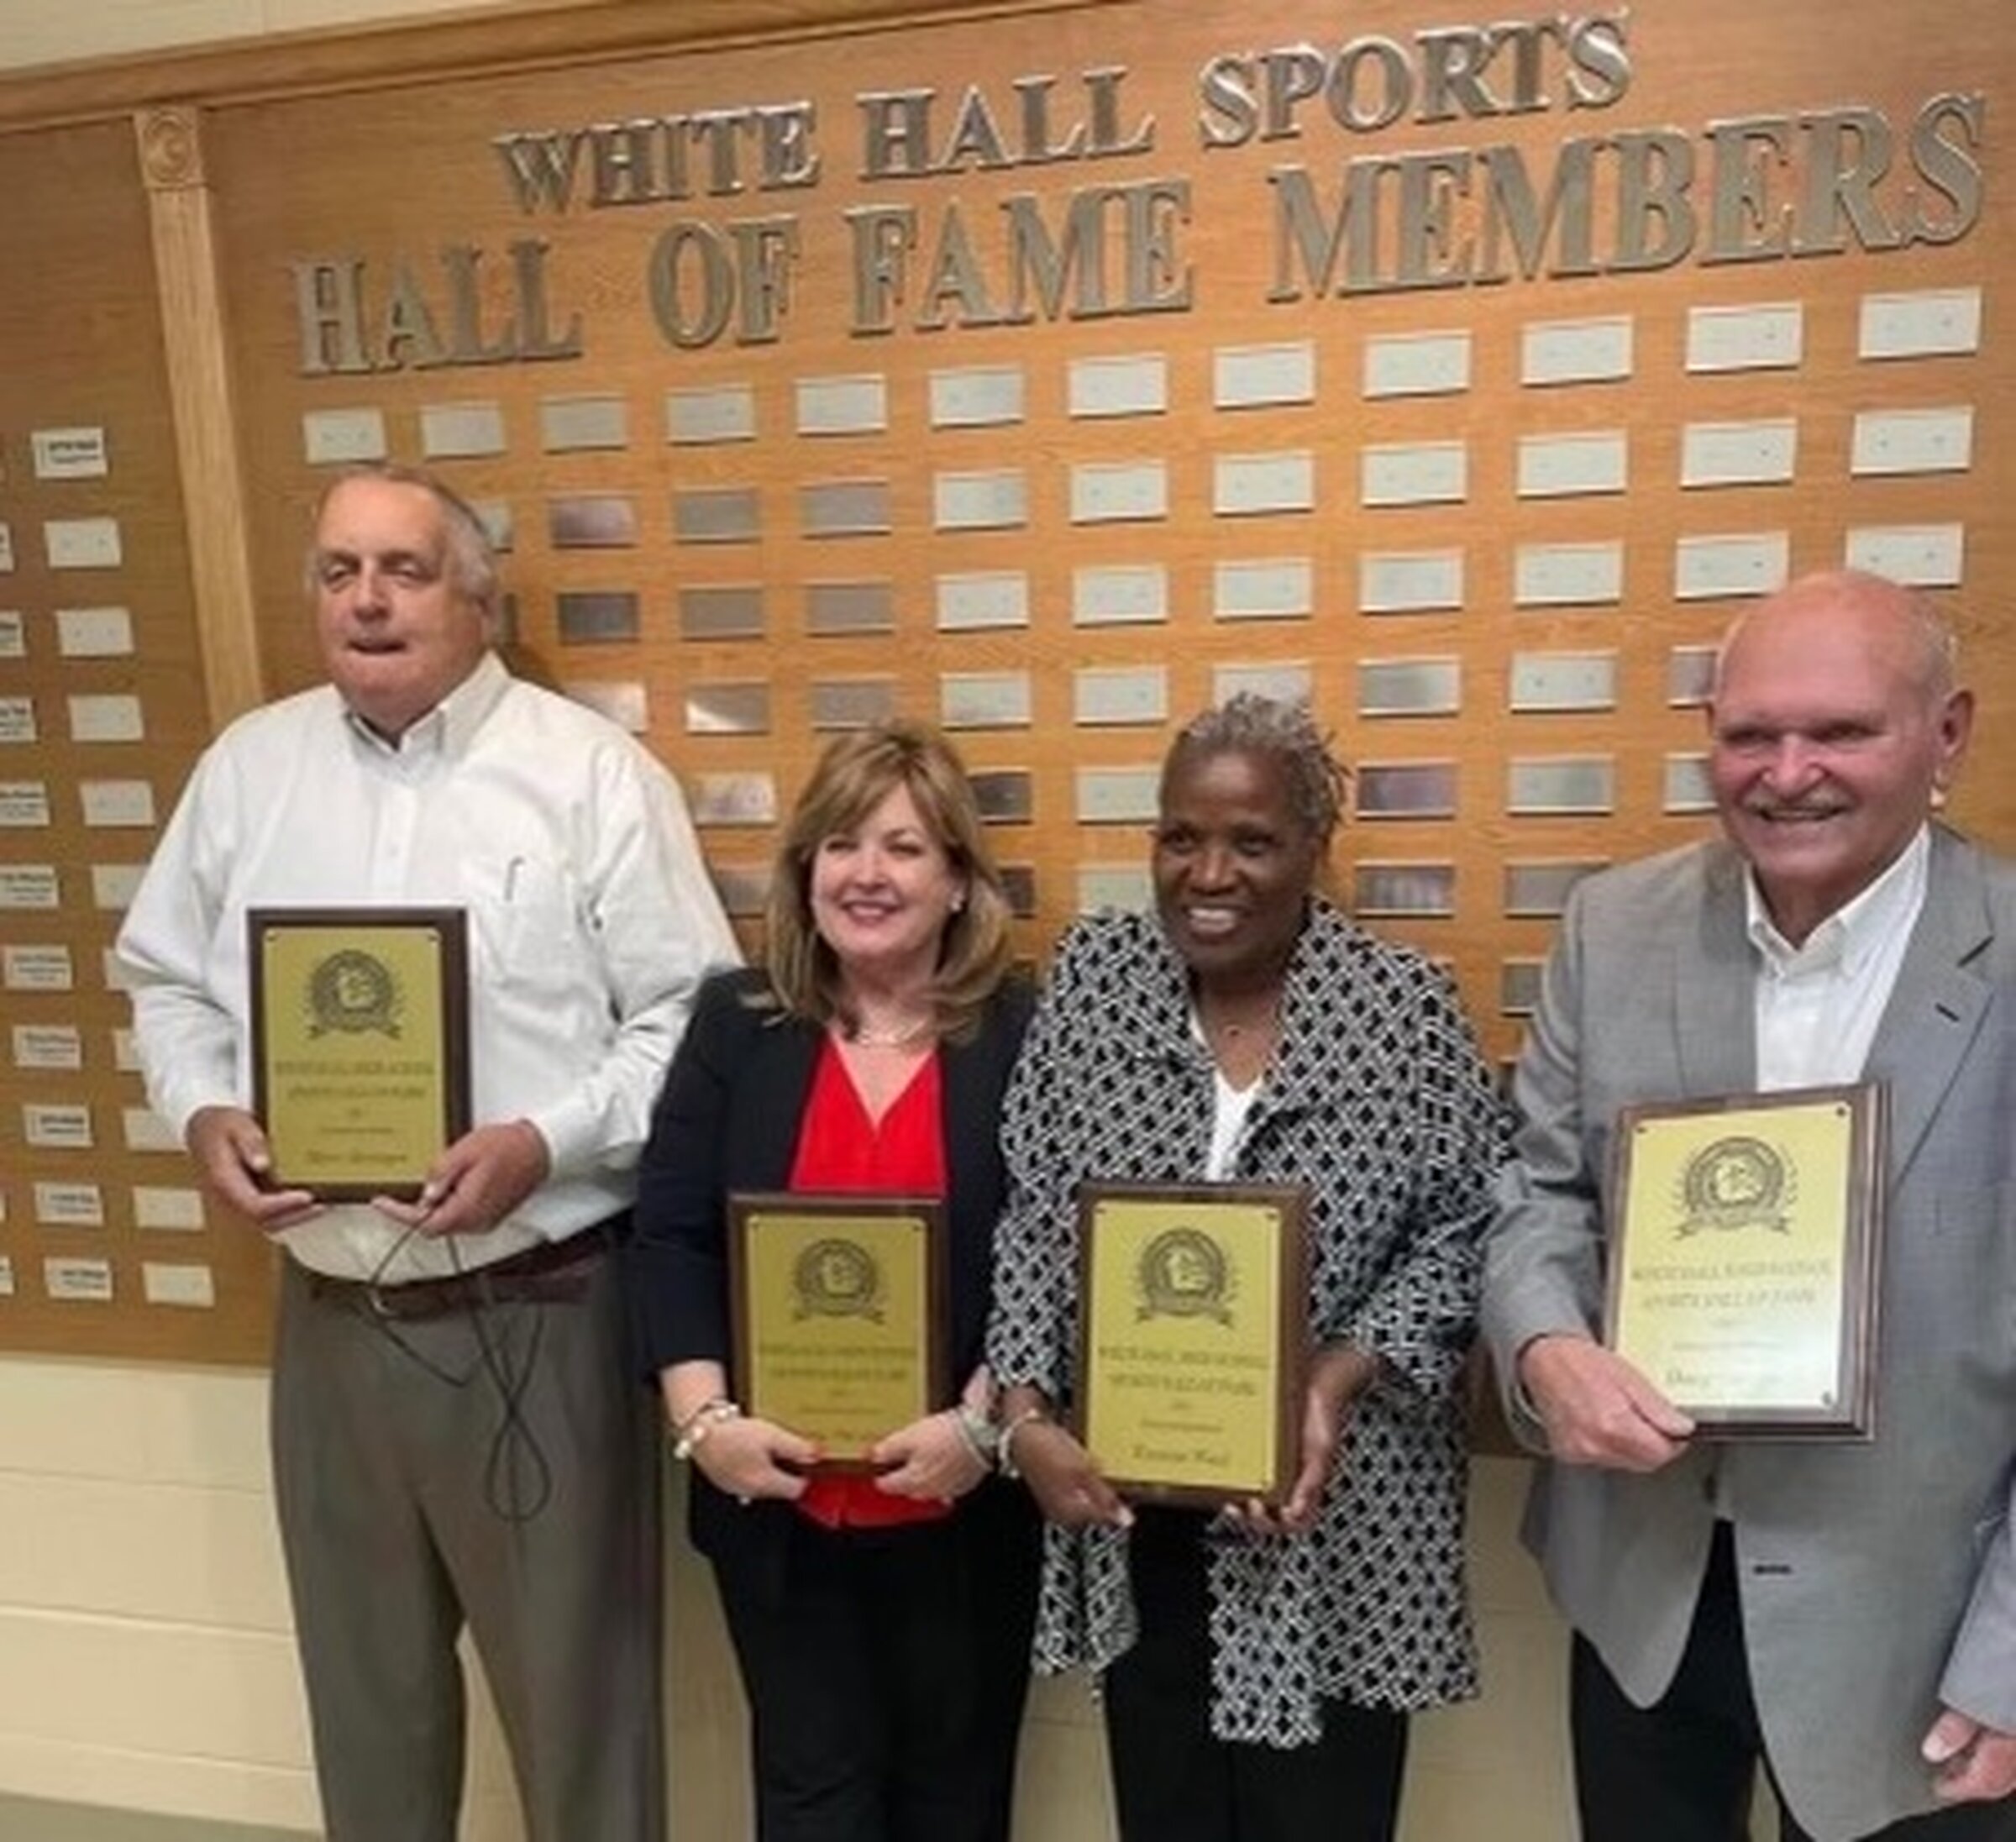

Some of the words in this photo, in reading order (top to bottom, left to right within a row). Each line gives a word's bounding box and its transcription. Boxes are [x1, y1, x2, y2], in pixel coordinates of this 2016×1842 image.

[491, 100, 818, 213] WHITE
[856, 67, 1154, 180] HALL
[1199, 8, 1631, 149] SPORTS
[293, 238, 582, 375] HALL
[648, 212, 798, 349] OF
[844, 174, 1192, 338] FAME
[1267, 91, 1987, 304] MEMBERS
